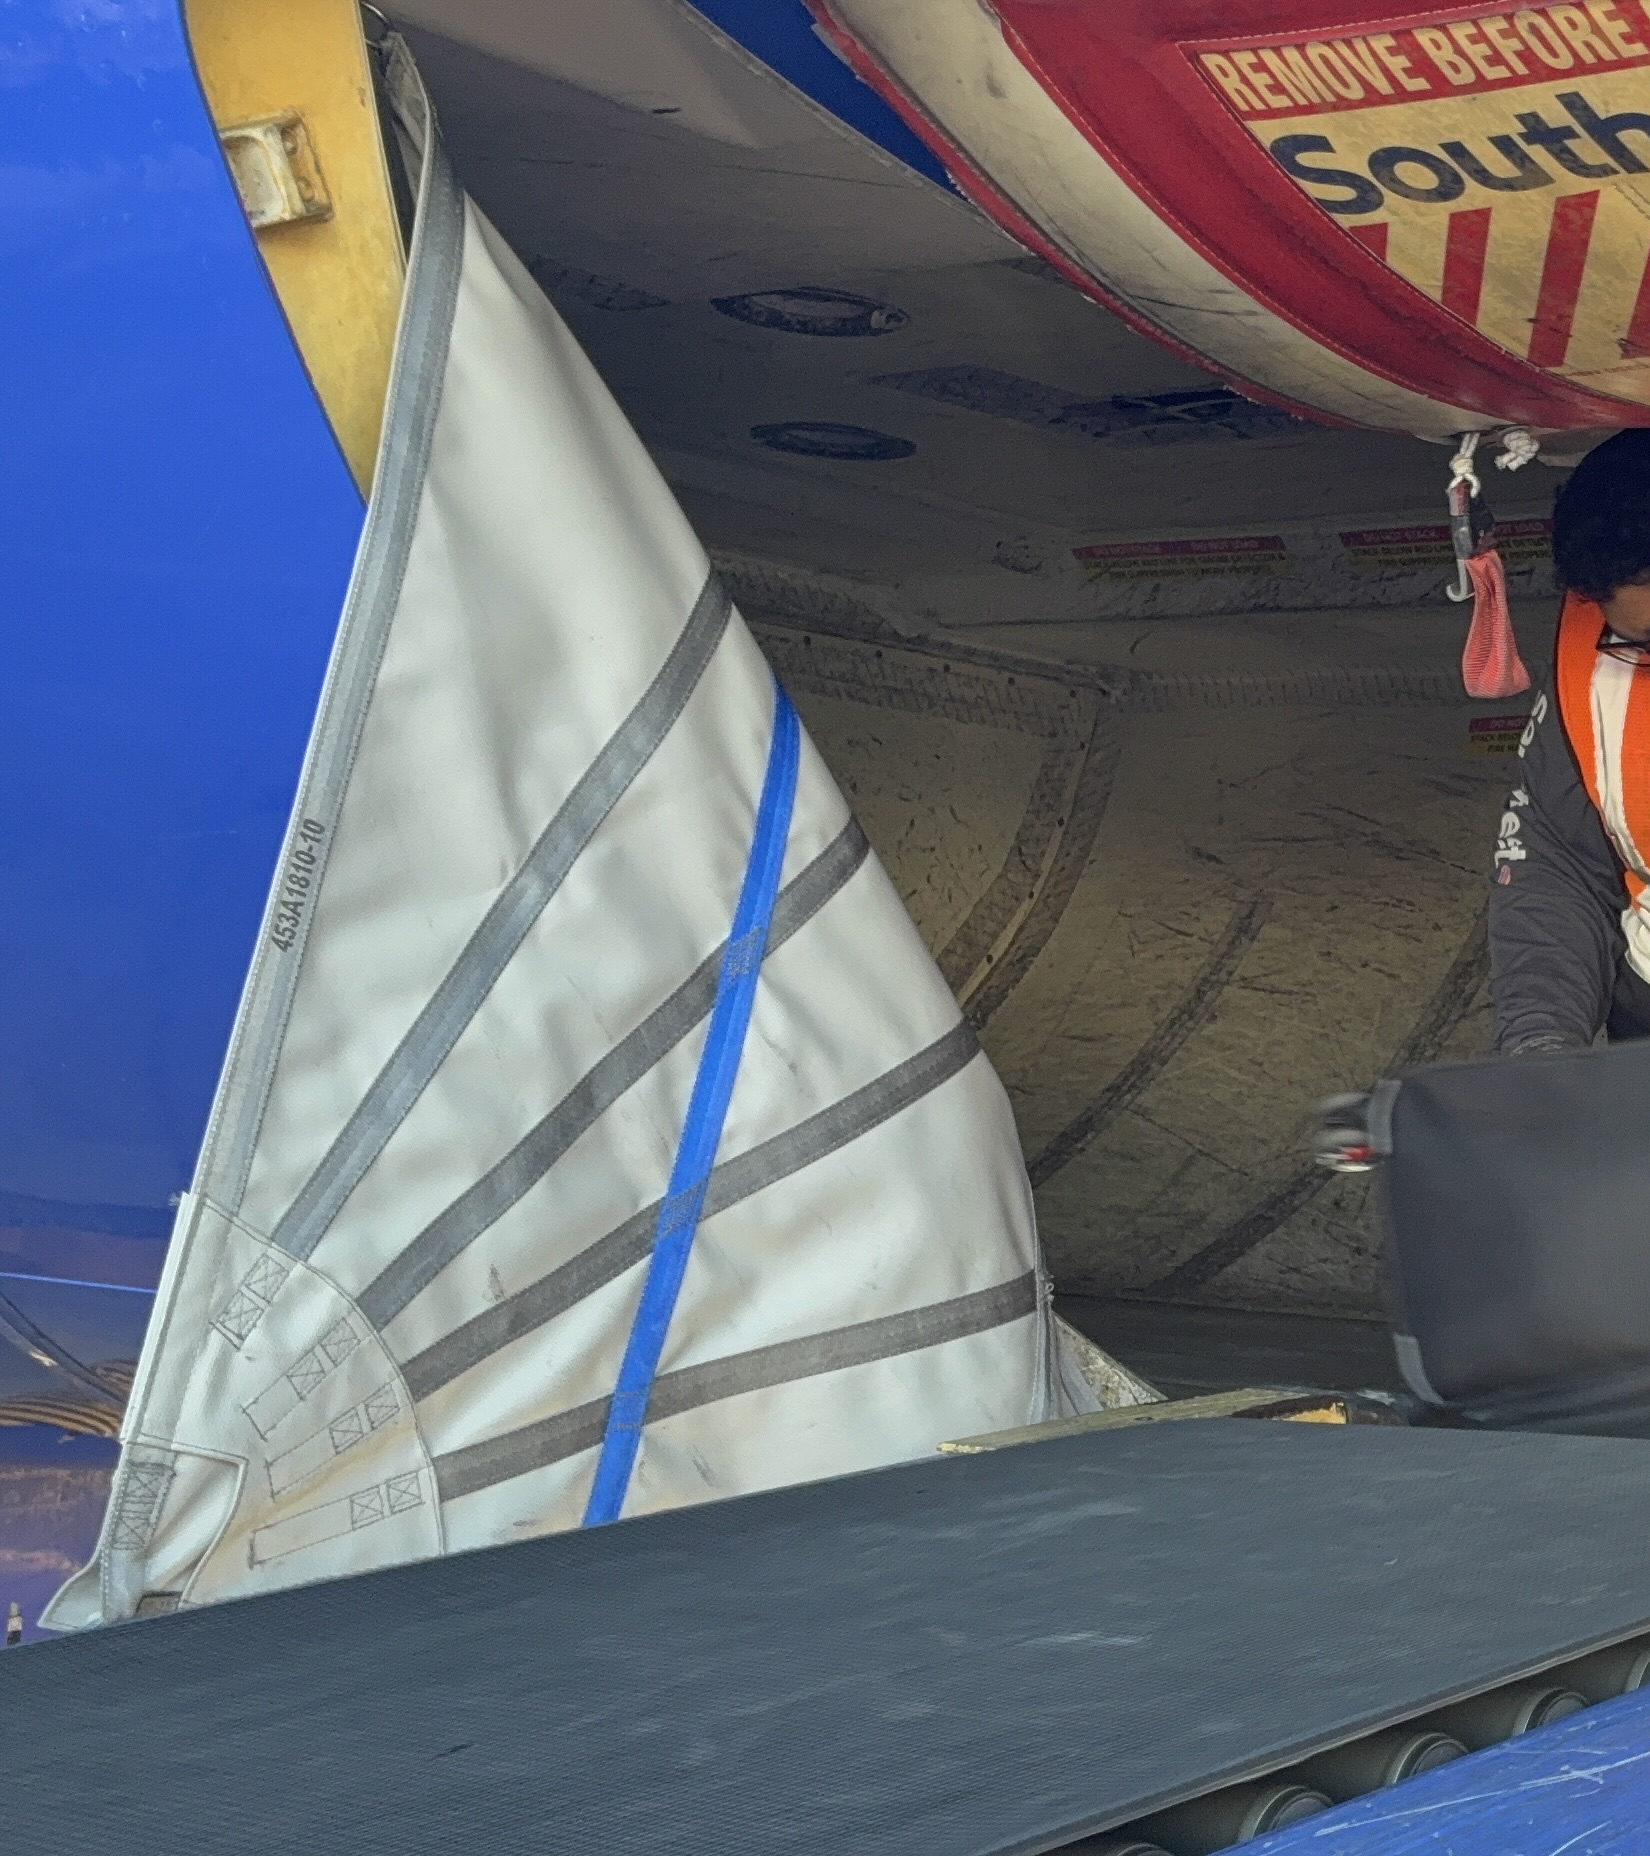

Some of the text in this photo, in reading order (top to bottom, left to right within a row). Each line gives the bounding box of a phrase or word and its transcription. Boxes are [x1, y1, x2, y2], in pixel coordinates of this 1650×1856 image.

[1202, 33, 1421, 112] REMOVE
[1413, 2, 1649, 87] BEFORE
[271, 818, 326, 953] 453A1810-10
